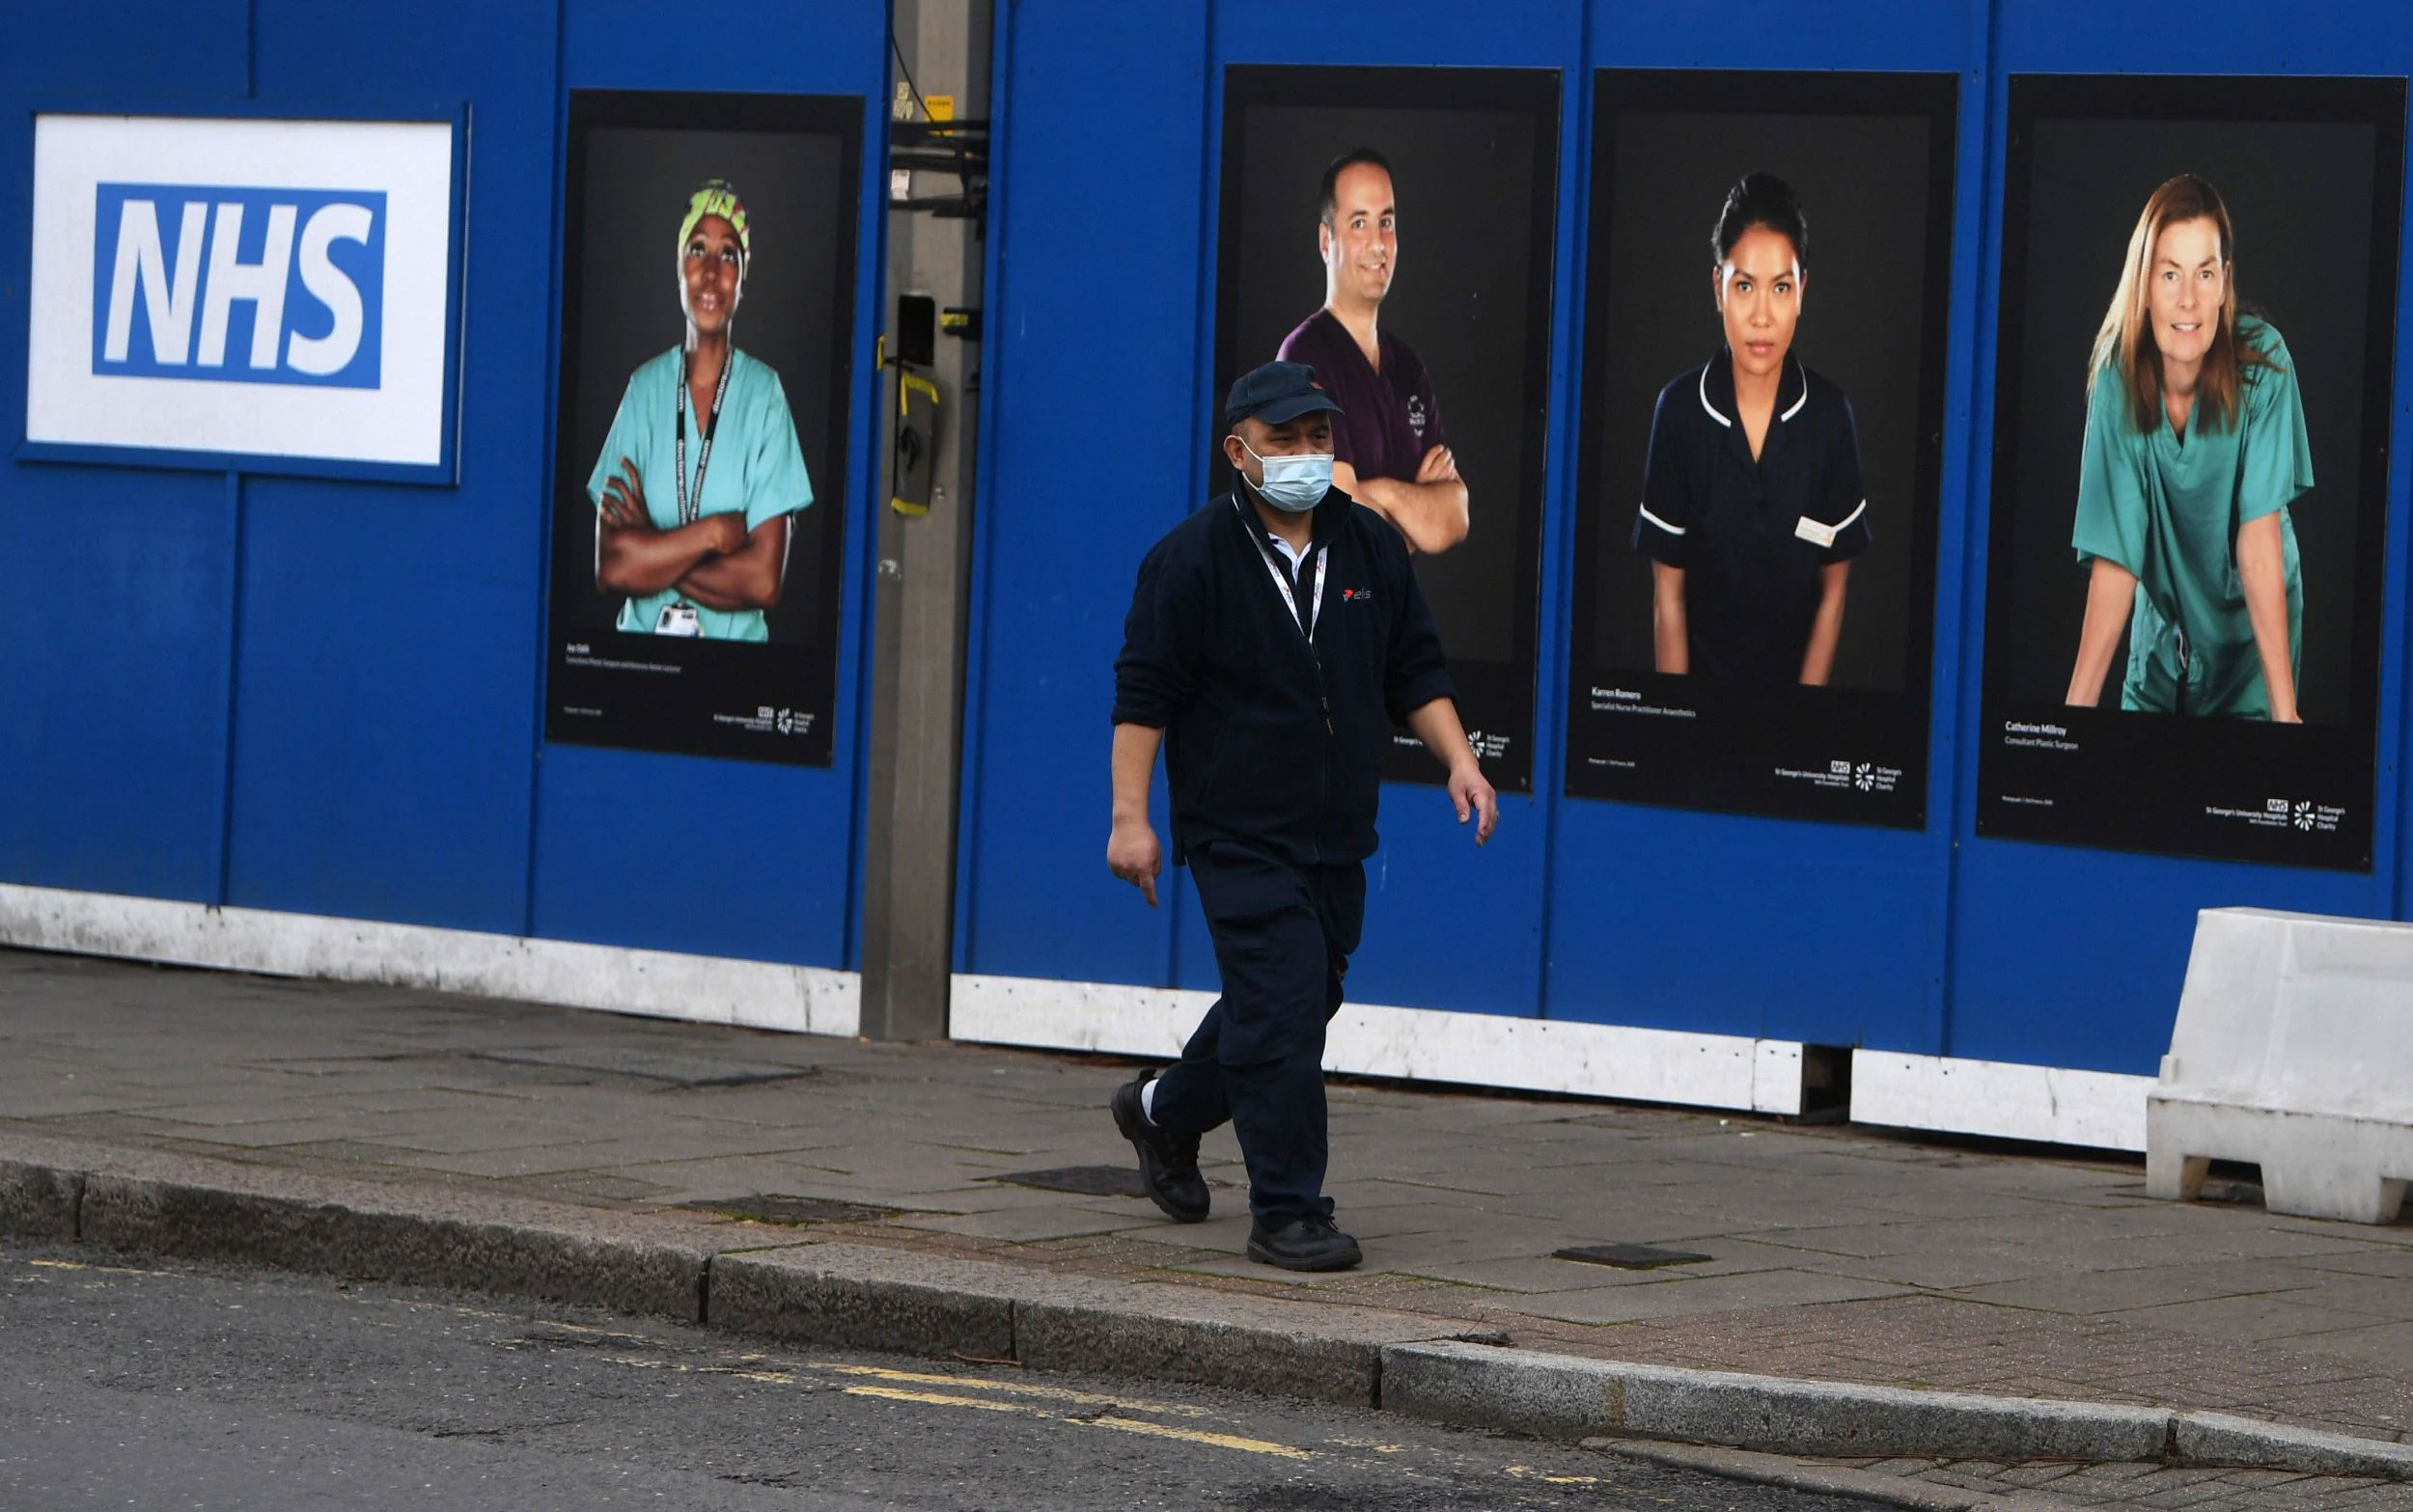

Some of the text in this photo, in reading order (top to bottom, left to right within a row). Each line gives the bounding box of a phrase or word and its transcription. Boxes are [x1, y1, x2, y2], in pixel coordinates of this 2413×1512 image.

[103, 199, 374, 376] NHS
[1353, 587, 1372, 600] elis
[1615, 688, 1642, 701] Romero
[1615, 702, 1631, 712] Nurse
[2005, 721, 2040, 733] Catherine
[2004, 735, 2079, 751] Consultant Plastic Surgeon
[2268, 800, 2288, 811] NHS
[2317, 813, 2339, 822] Hospital
[2316, 822, 2337, 831] Charity
